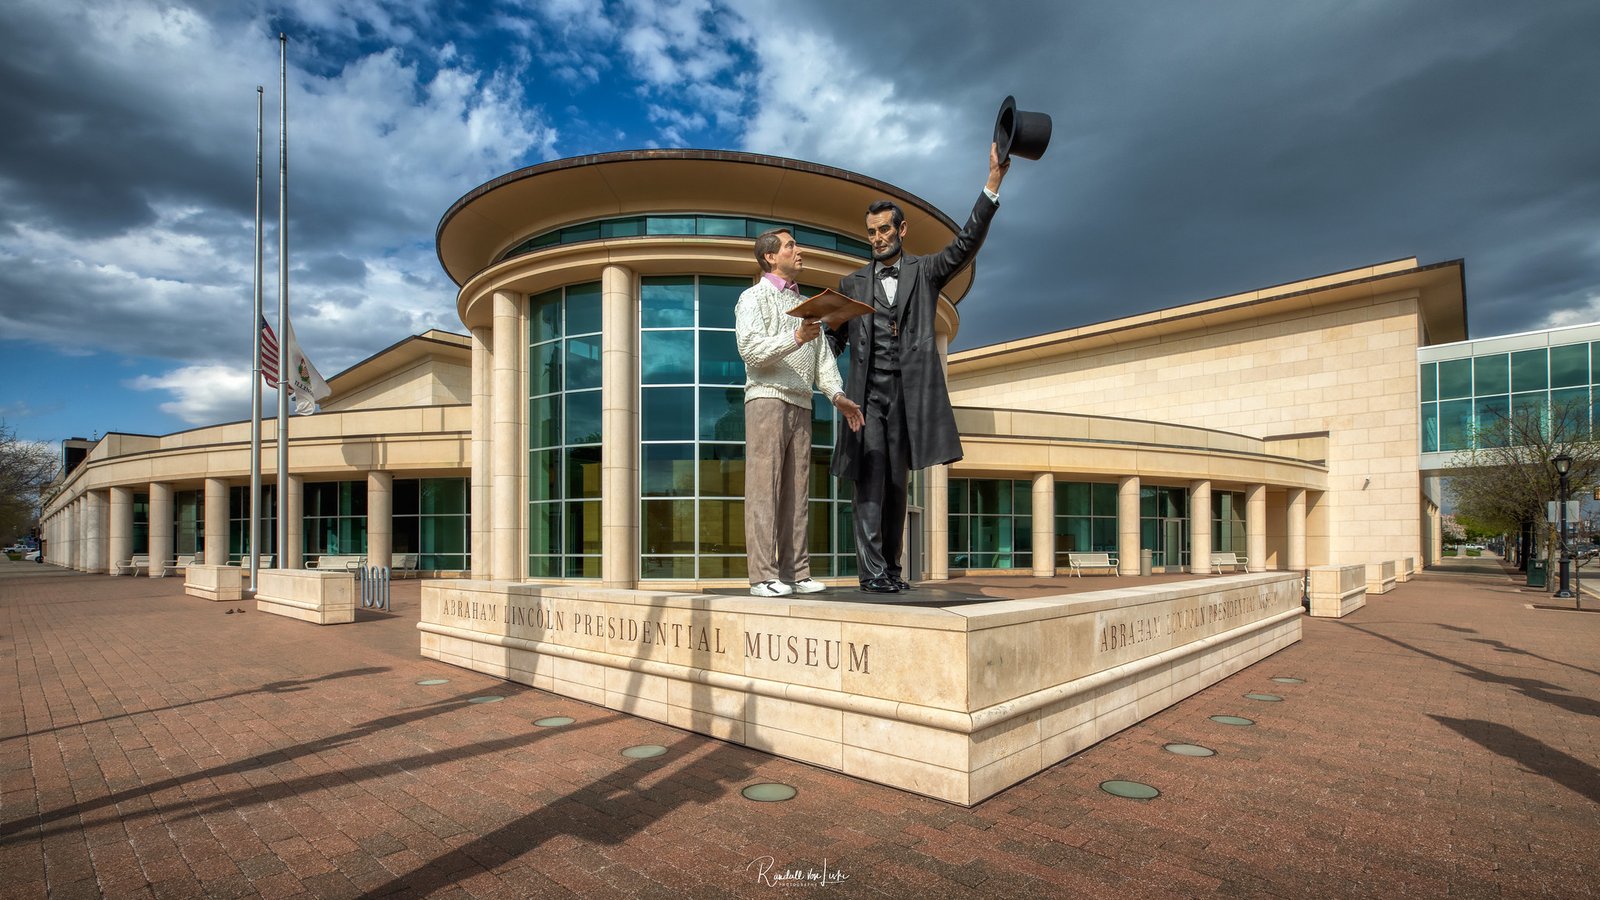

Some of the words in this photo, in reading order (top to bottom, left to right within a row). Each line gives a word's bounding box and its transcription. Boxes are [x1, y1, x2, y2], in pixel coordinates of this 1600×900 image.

[443, 599, 497, 622] ABRAHAM
[504, 605, 565, 632] LINCOLN
[573, 612, 727, 654] PRESIDENTIAL
[744, 631, 870, 675] MUSEUM
[1100, 614, 1161, 652] ABRAHAM
